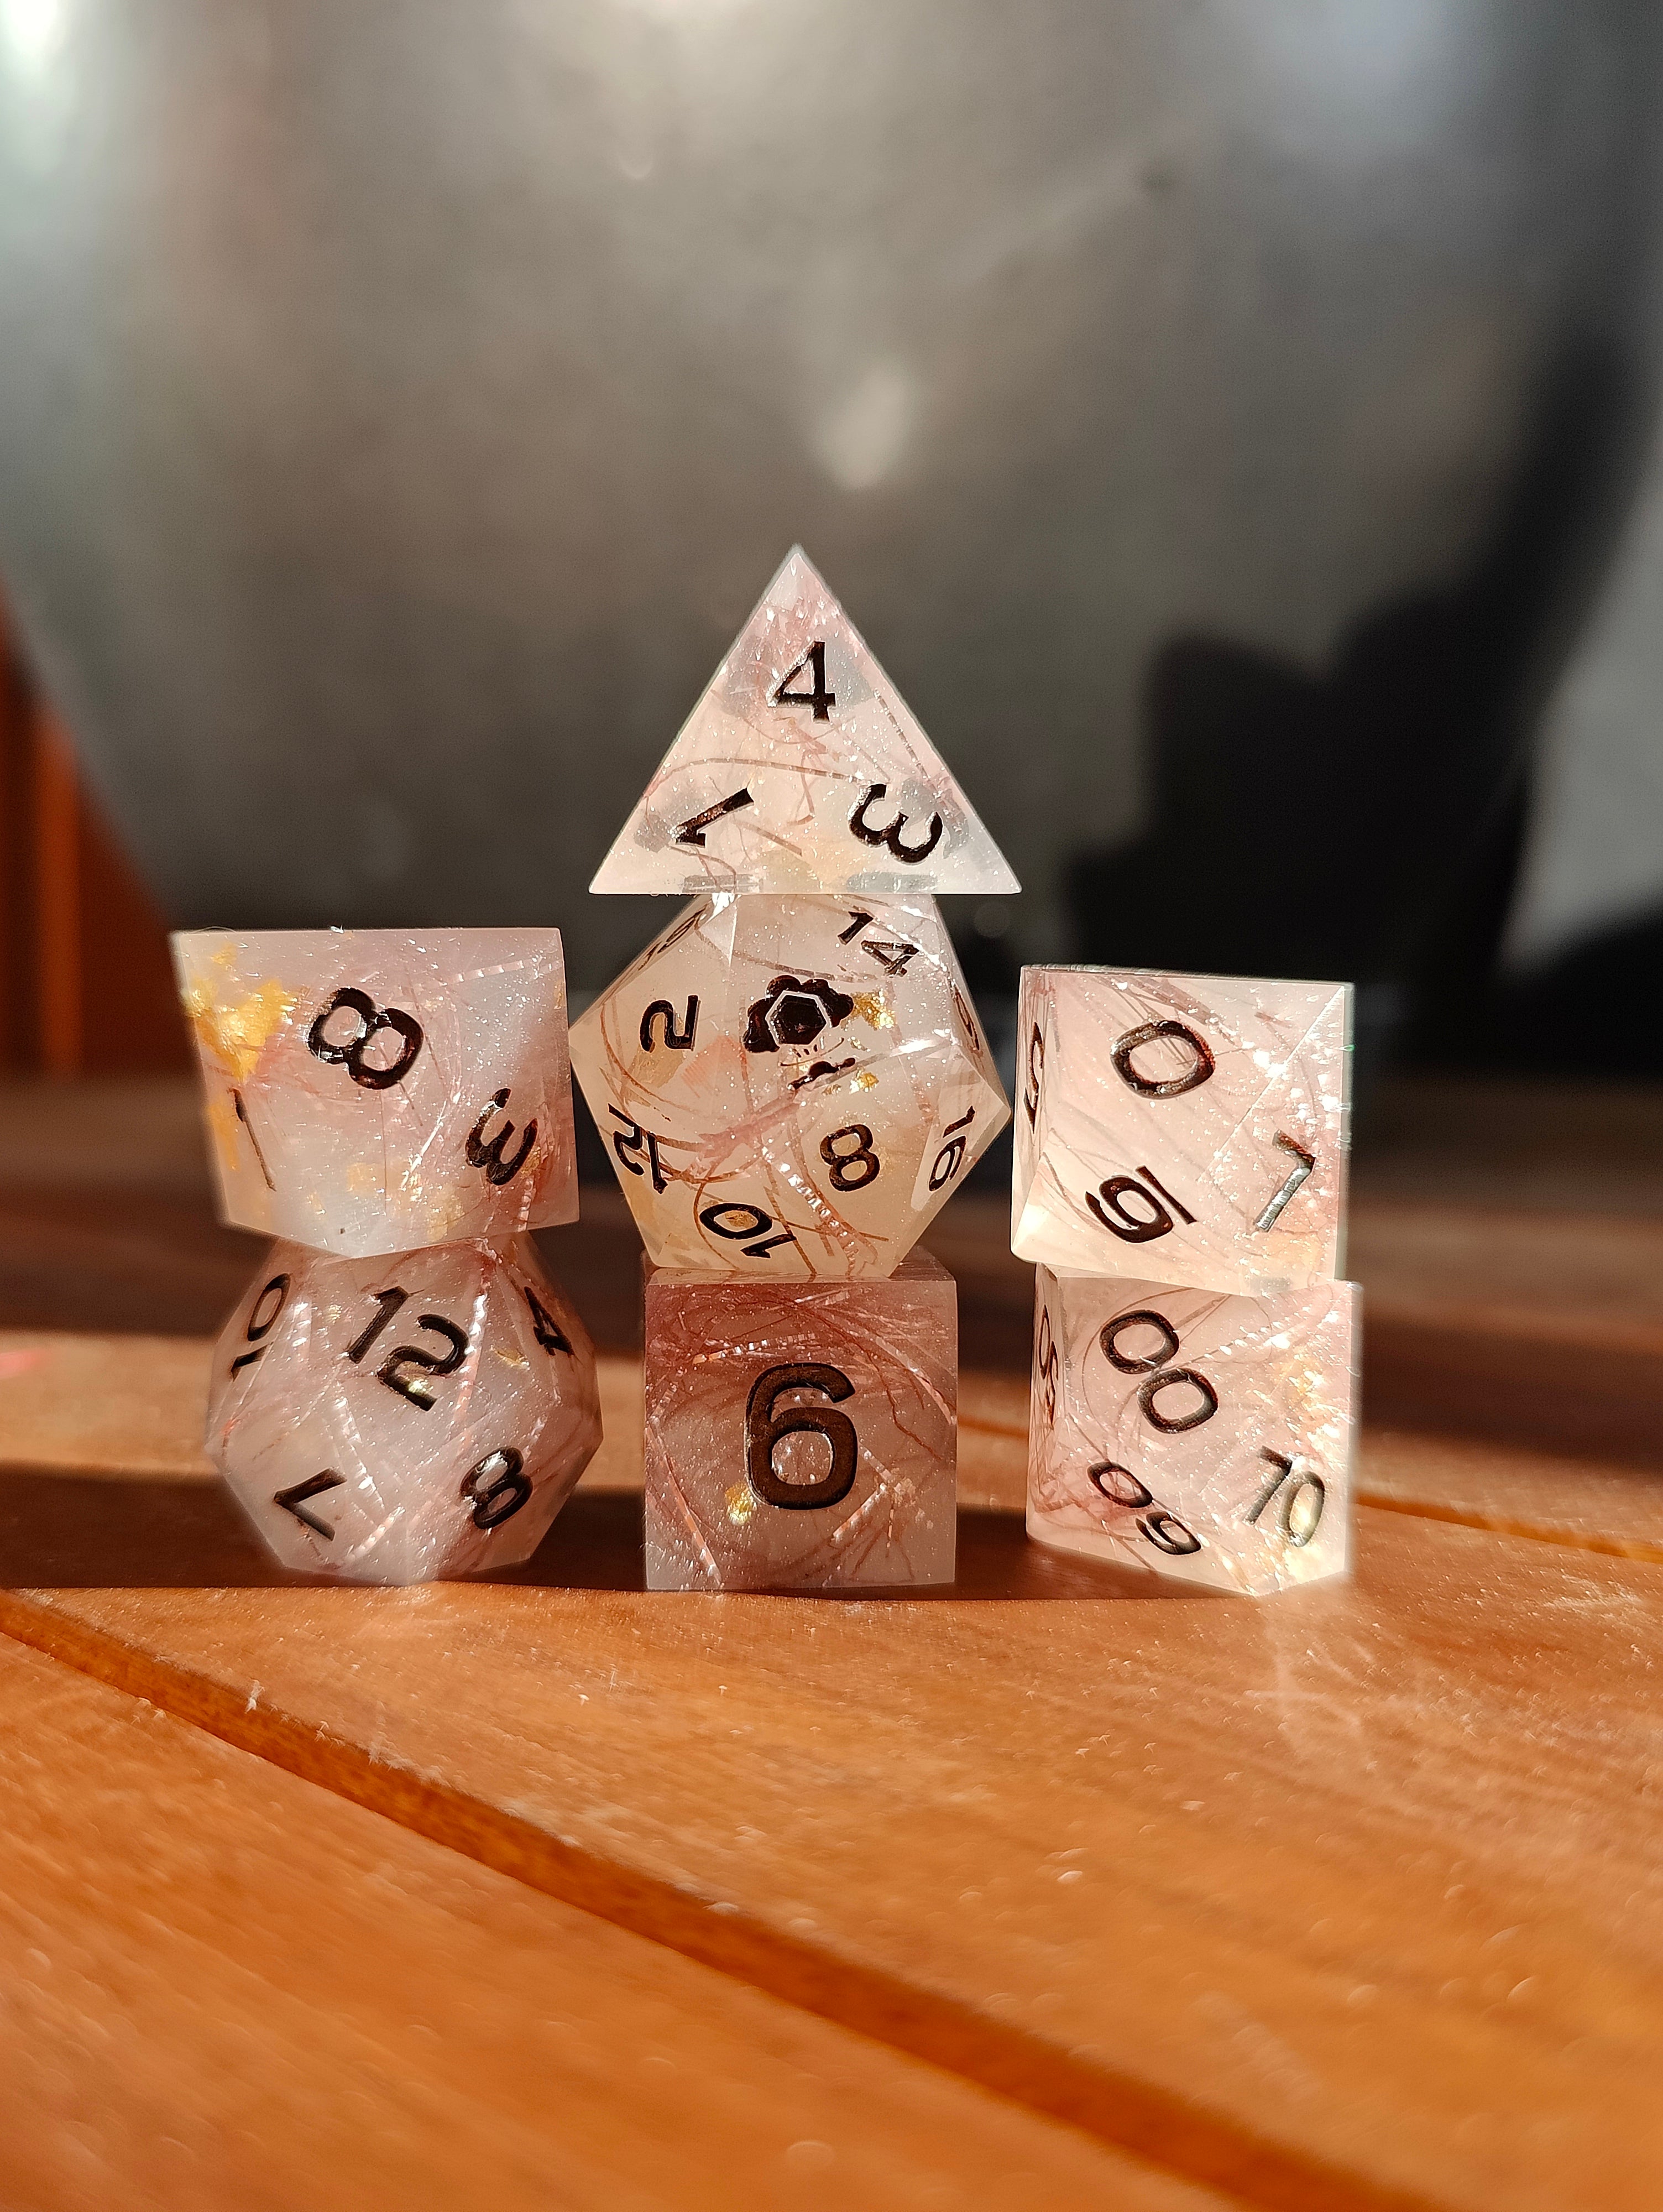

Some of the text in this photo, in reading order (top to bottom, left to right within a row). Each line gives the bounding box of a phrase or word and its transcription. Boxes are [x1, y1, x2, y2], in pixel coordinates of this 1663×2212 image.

[767, 641, 836, 723] 4
[671, 787, 754, 847] 1
[848, 783, 943, 864] 3
[837, 911, 922, 978] 14
[307, 987, 425, 1091] 8
[639, 995, 699, 1052] 2
[1109, 1019, 1216, 1100] 0
[464, 1088, 538, 1186] 3
[608, 1103, 668, 1194] 12
[819, 1124, 881, 1192] 8
[1255, 1129, 1316, 1233] 7
[698, 1202, 797, 1260] 10
[231, 1273, 290, 1380] 10
[345, 1286, 471, 1412] 12
[524, 1286, 576, 1358] 4
[1099, 1309, 1219, 1434] 00
[744, 1361, 859, 1510] 6
[460, 1446, 534, 1531] 8
[1243, 1445, 1326, 1548] 70
